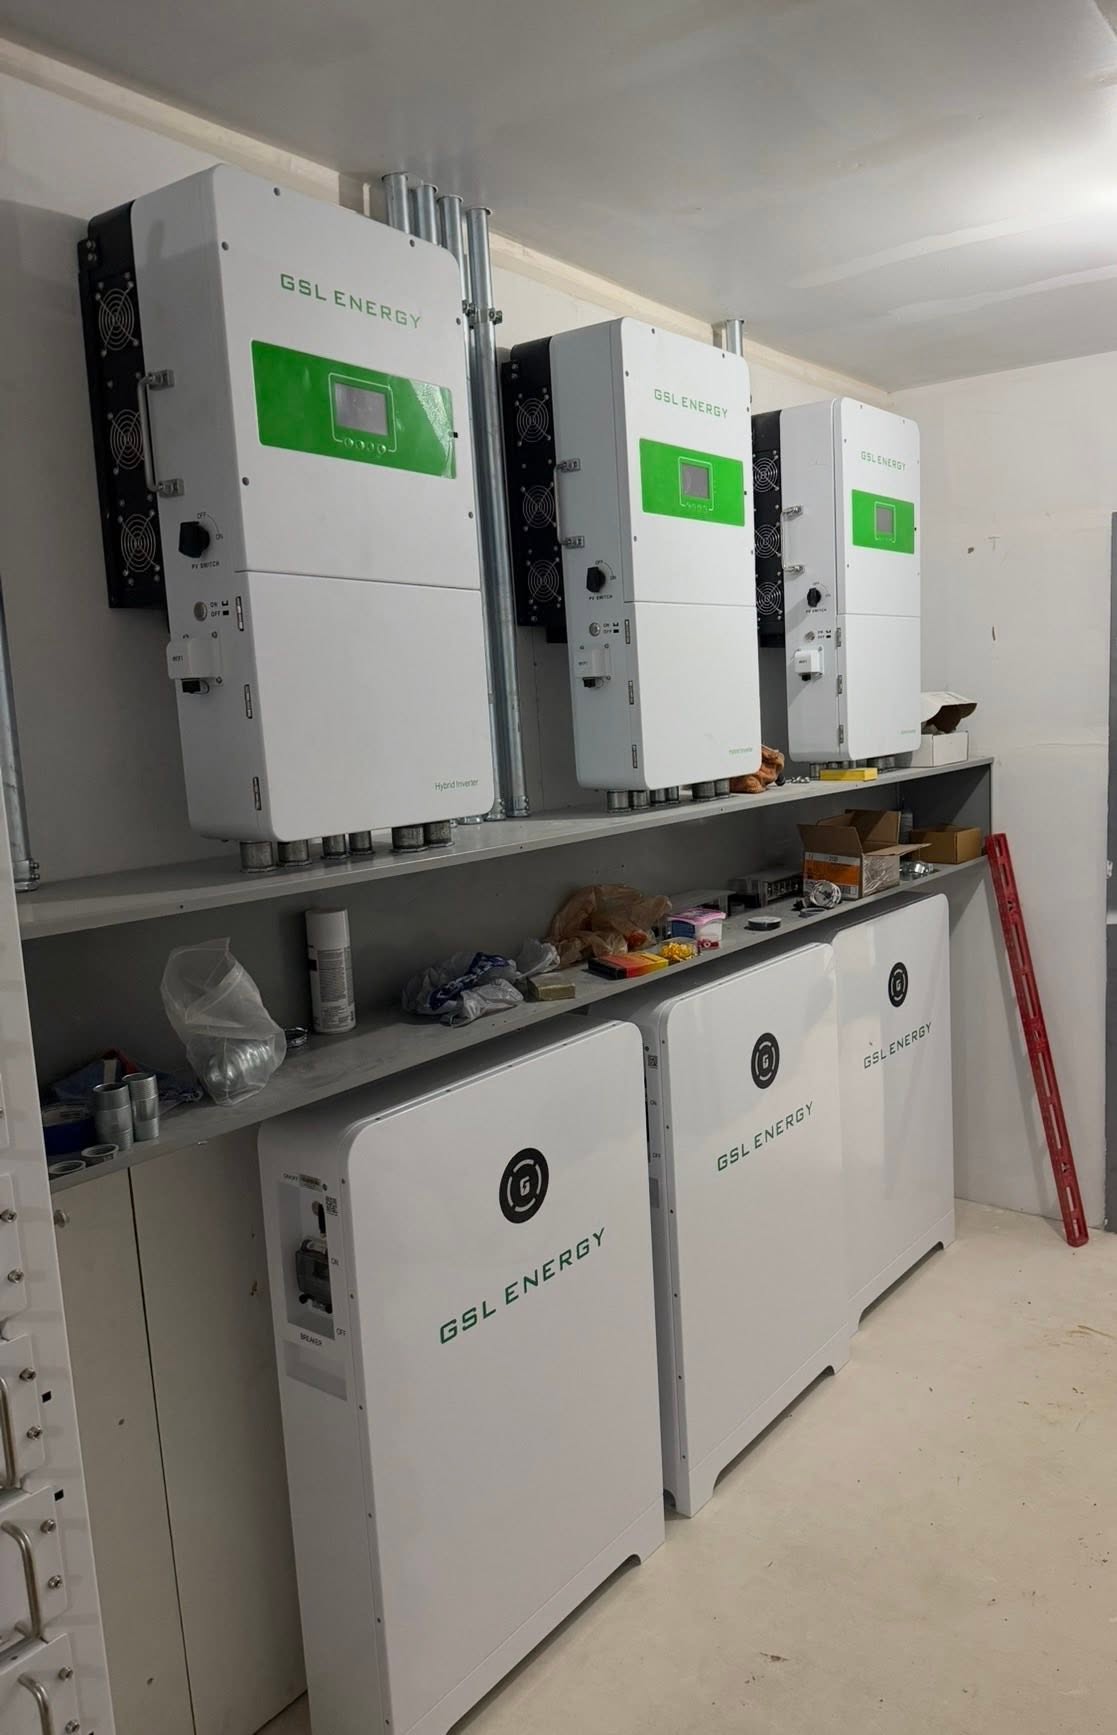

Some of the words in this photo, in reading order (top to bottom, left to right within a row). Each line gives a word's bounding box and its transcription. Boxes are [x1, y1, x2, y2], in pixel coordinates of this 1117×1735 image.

[280, 273, 327, 301] GSL
[334, 290, 421, 329] ENERGY
[654, 388, 679, 405] GSL
[681, 396, 728, 419] ENERGY
[860, 450, 876, 463] GSL
[877, 455, 906, 471] ENERGY
[200, 560, 220, 568] SWITCH
[434, 780, 456, 792] Hybrid
[456, 779, 479, 788] Inverter
[863, 1048, 887, 1069] GSL
[889, 1021, 932, 1056] ENERGY
[717, 1143, 750, 1172] GSL
[754, 1101, 813, 1149] ENERGY
[440, 1301, 497, 1344] GSL
[505, 1227, 605, 1305] ENERGY
